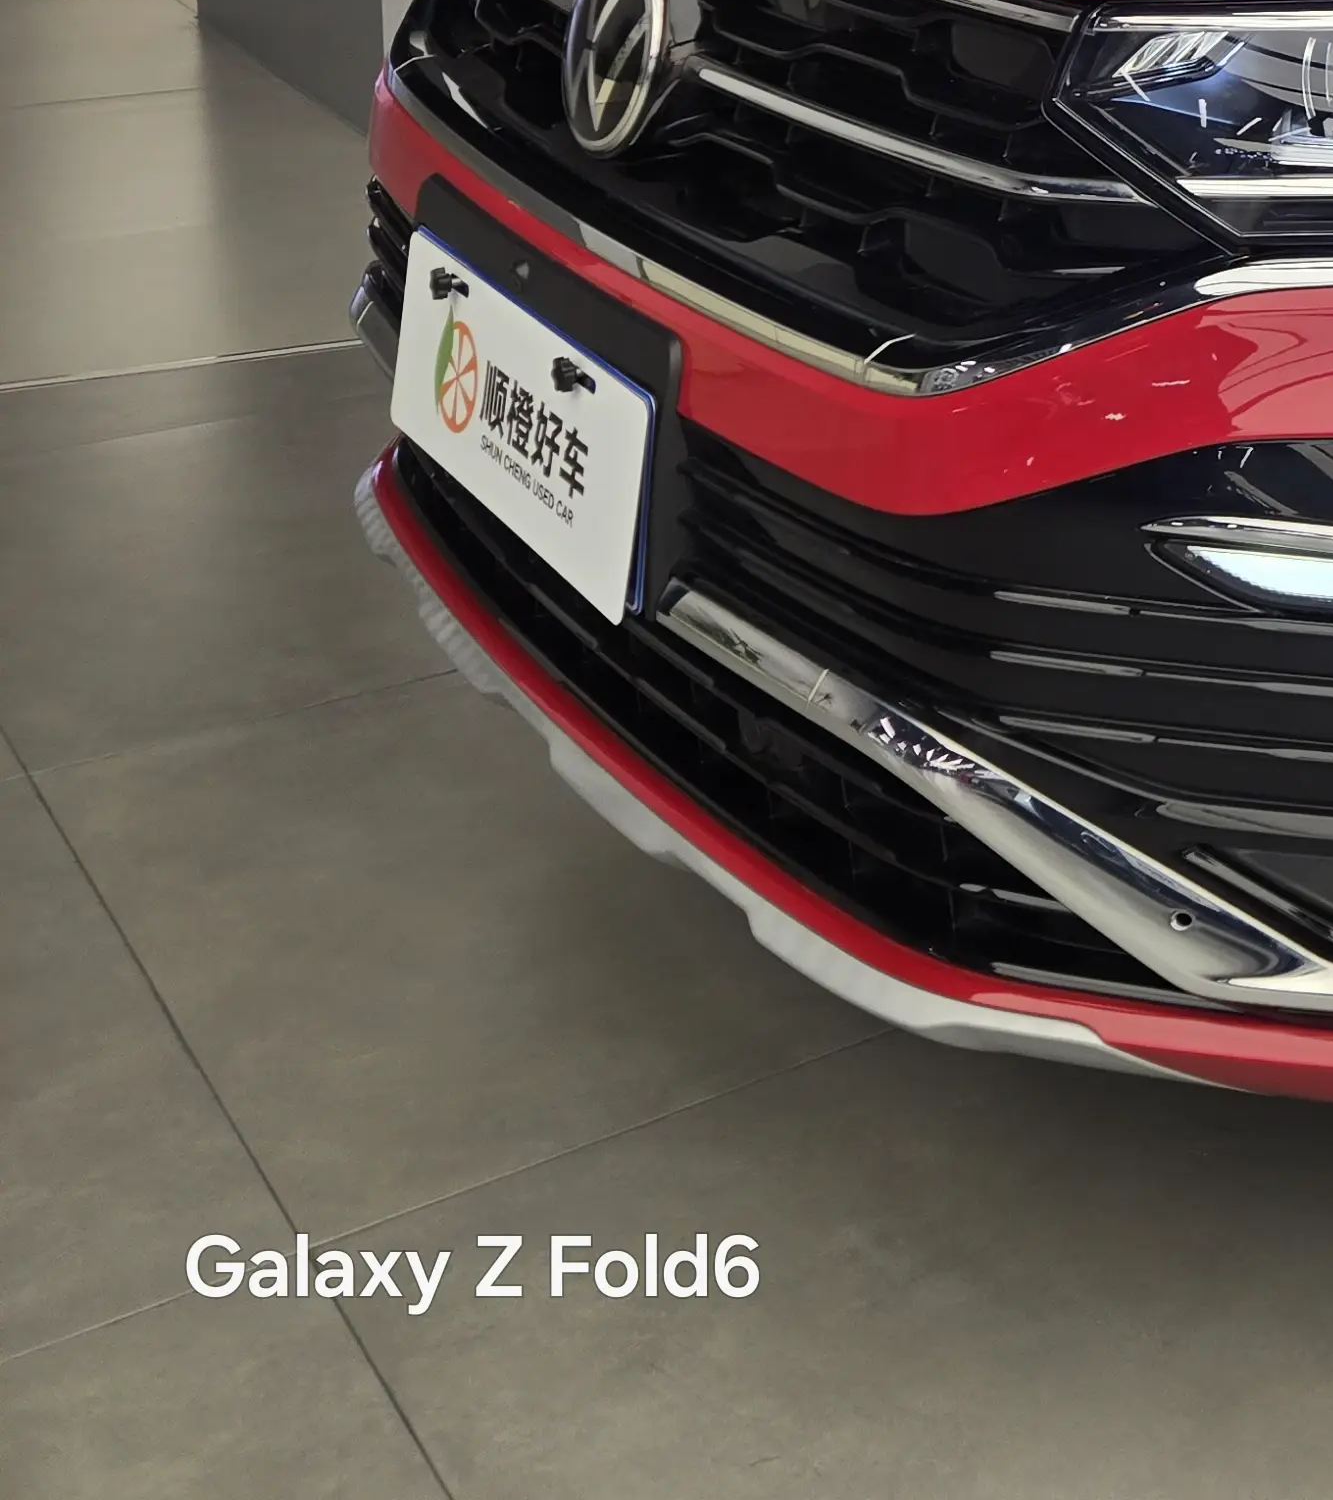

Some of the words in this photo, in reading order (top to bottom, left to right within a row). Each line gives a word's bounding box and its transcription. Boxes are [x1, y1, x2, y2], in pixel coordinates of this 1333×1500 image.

[479, 359, 589, 500] 顺橙好车
[480, 434, 503, 465] SHUN
[503, 454, 532, 490] CHENG
[532, 480, 555, 510] USED
[555, 500, 574, 528] CAR
